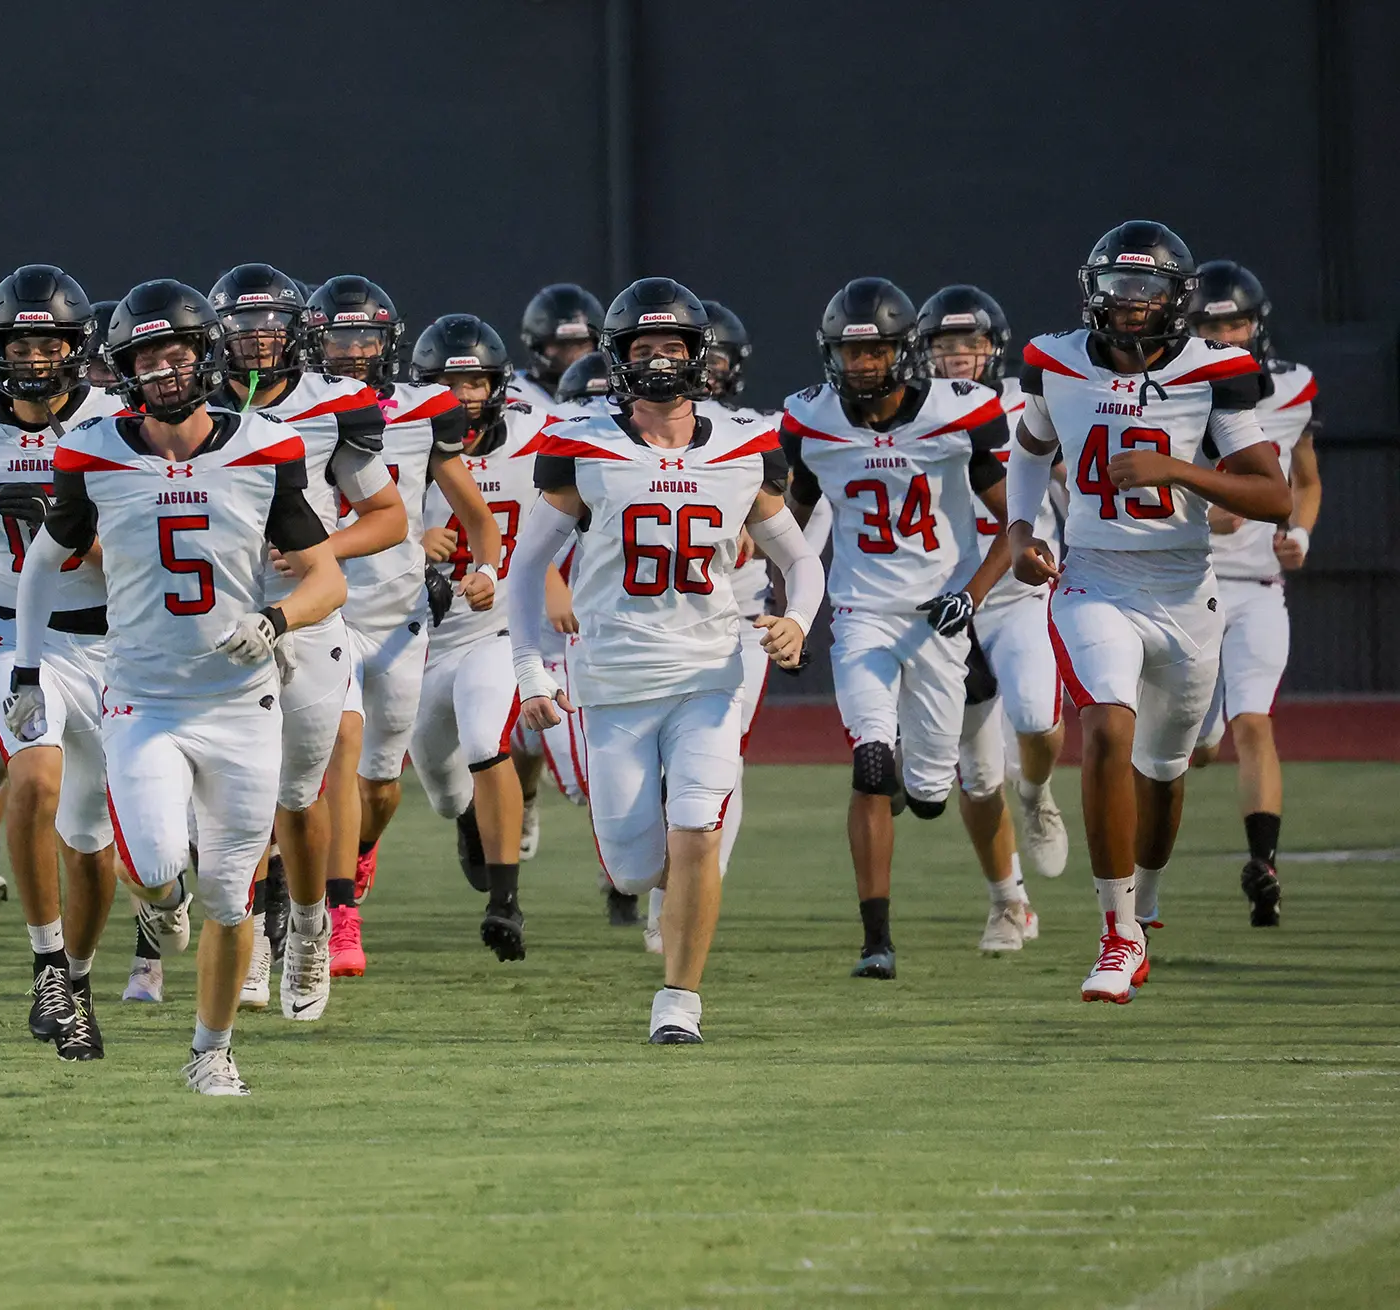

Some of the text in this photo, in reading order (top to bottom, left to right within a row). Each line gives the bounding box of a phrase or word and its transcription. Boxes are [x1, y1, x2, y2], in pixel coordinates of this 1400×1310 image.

[1120, 255, 1151, 263] Riddell
[240, 294, 270, 302] Riddell
[19, 313, 49, 321] Riddell
[643, 314, 672, 322] Riddell
[135, 321, 166, 333] Riddell
[1095, 402, 1143, 417] JAGUARS
[7, 459, 54, 472] JAGUARS
[865, 456, 907, 469] JAGUARS
[1076, 424, 1175, 520] 43
[649, 480, 698, 493] JAGUARS
[156, 491, 208, 505] JAGUARS
[845, 473, 940, 554] 34
[622, 502, 723, 596] 66
[157, 515, 216, 616] 5
